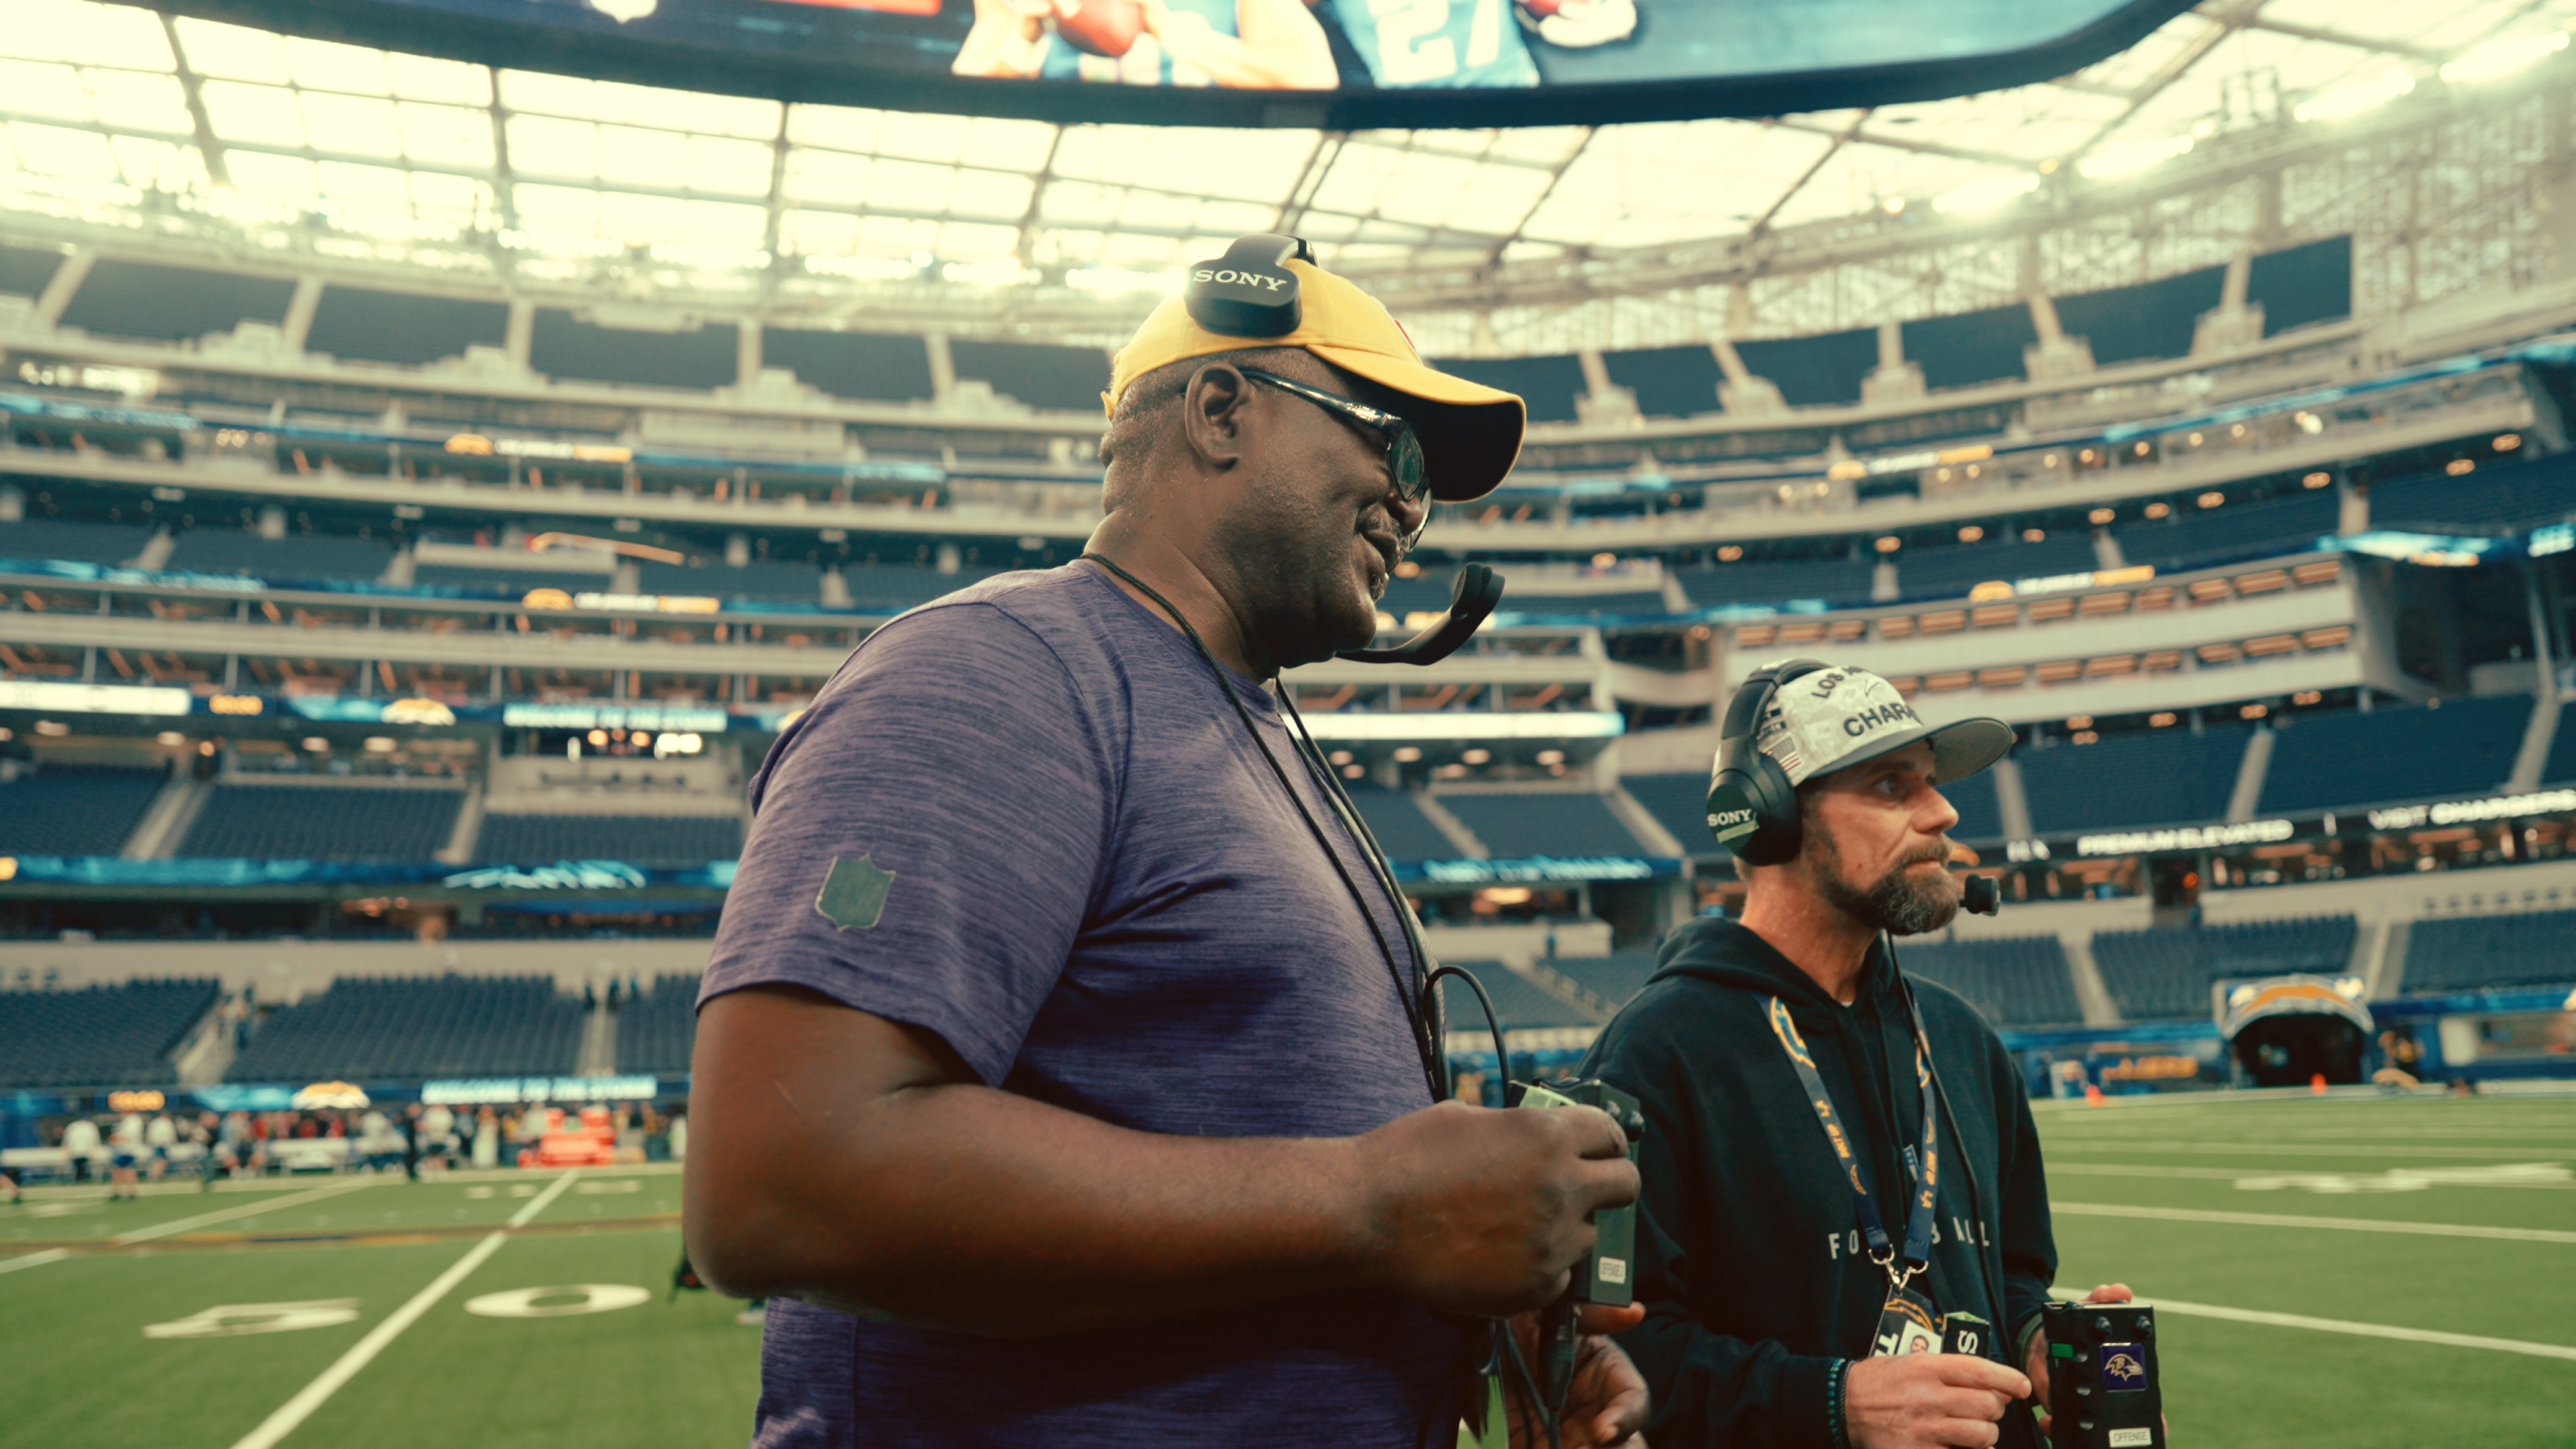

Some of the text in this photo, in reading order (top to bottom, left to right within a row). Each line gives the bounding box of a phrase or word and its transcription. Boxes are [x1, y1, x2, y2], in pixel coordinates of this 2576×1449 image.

[1193, 269, 1287, 291] SONY
[1811, 673, 1845, 699] LOS
[1707, 808, 1751, 827] SONY
[2077, 830, 2176, 856] PREMIUM
[2177, 820, 2294, 850] ELEVATED
[1829, 1216, 1990, 1259] FOBALL
[2113, 1431, 2147, 1443] OFFENSE
